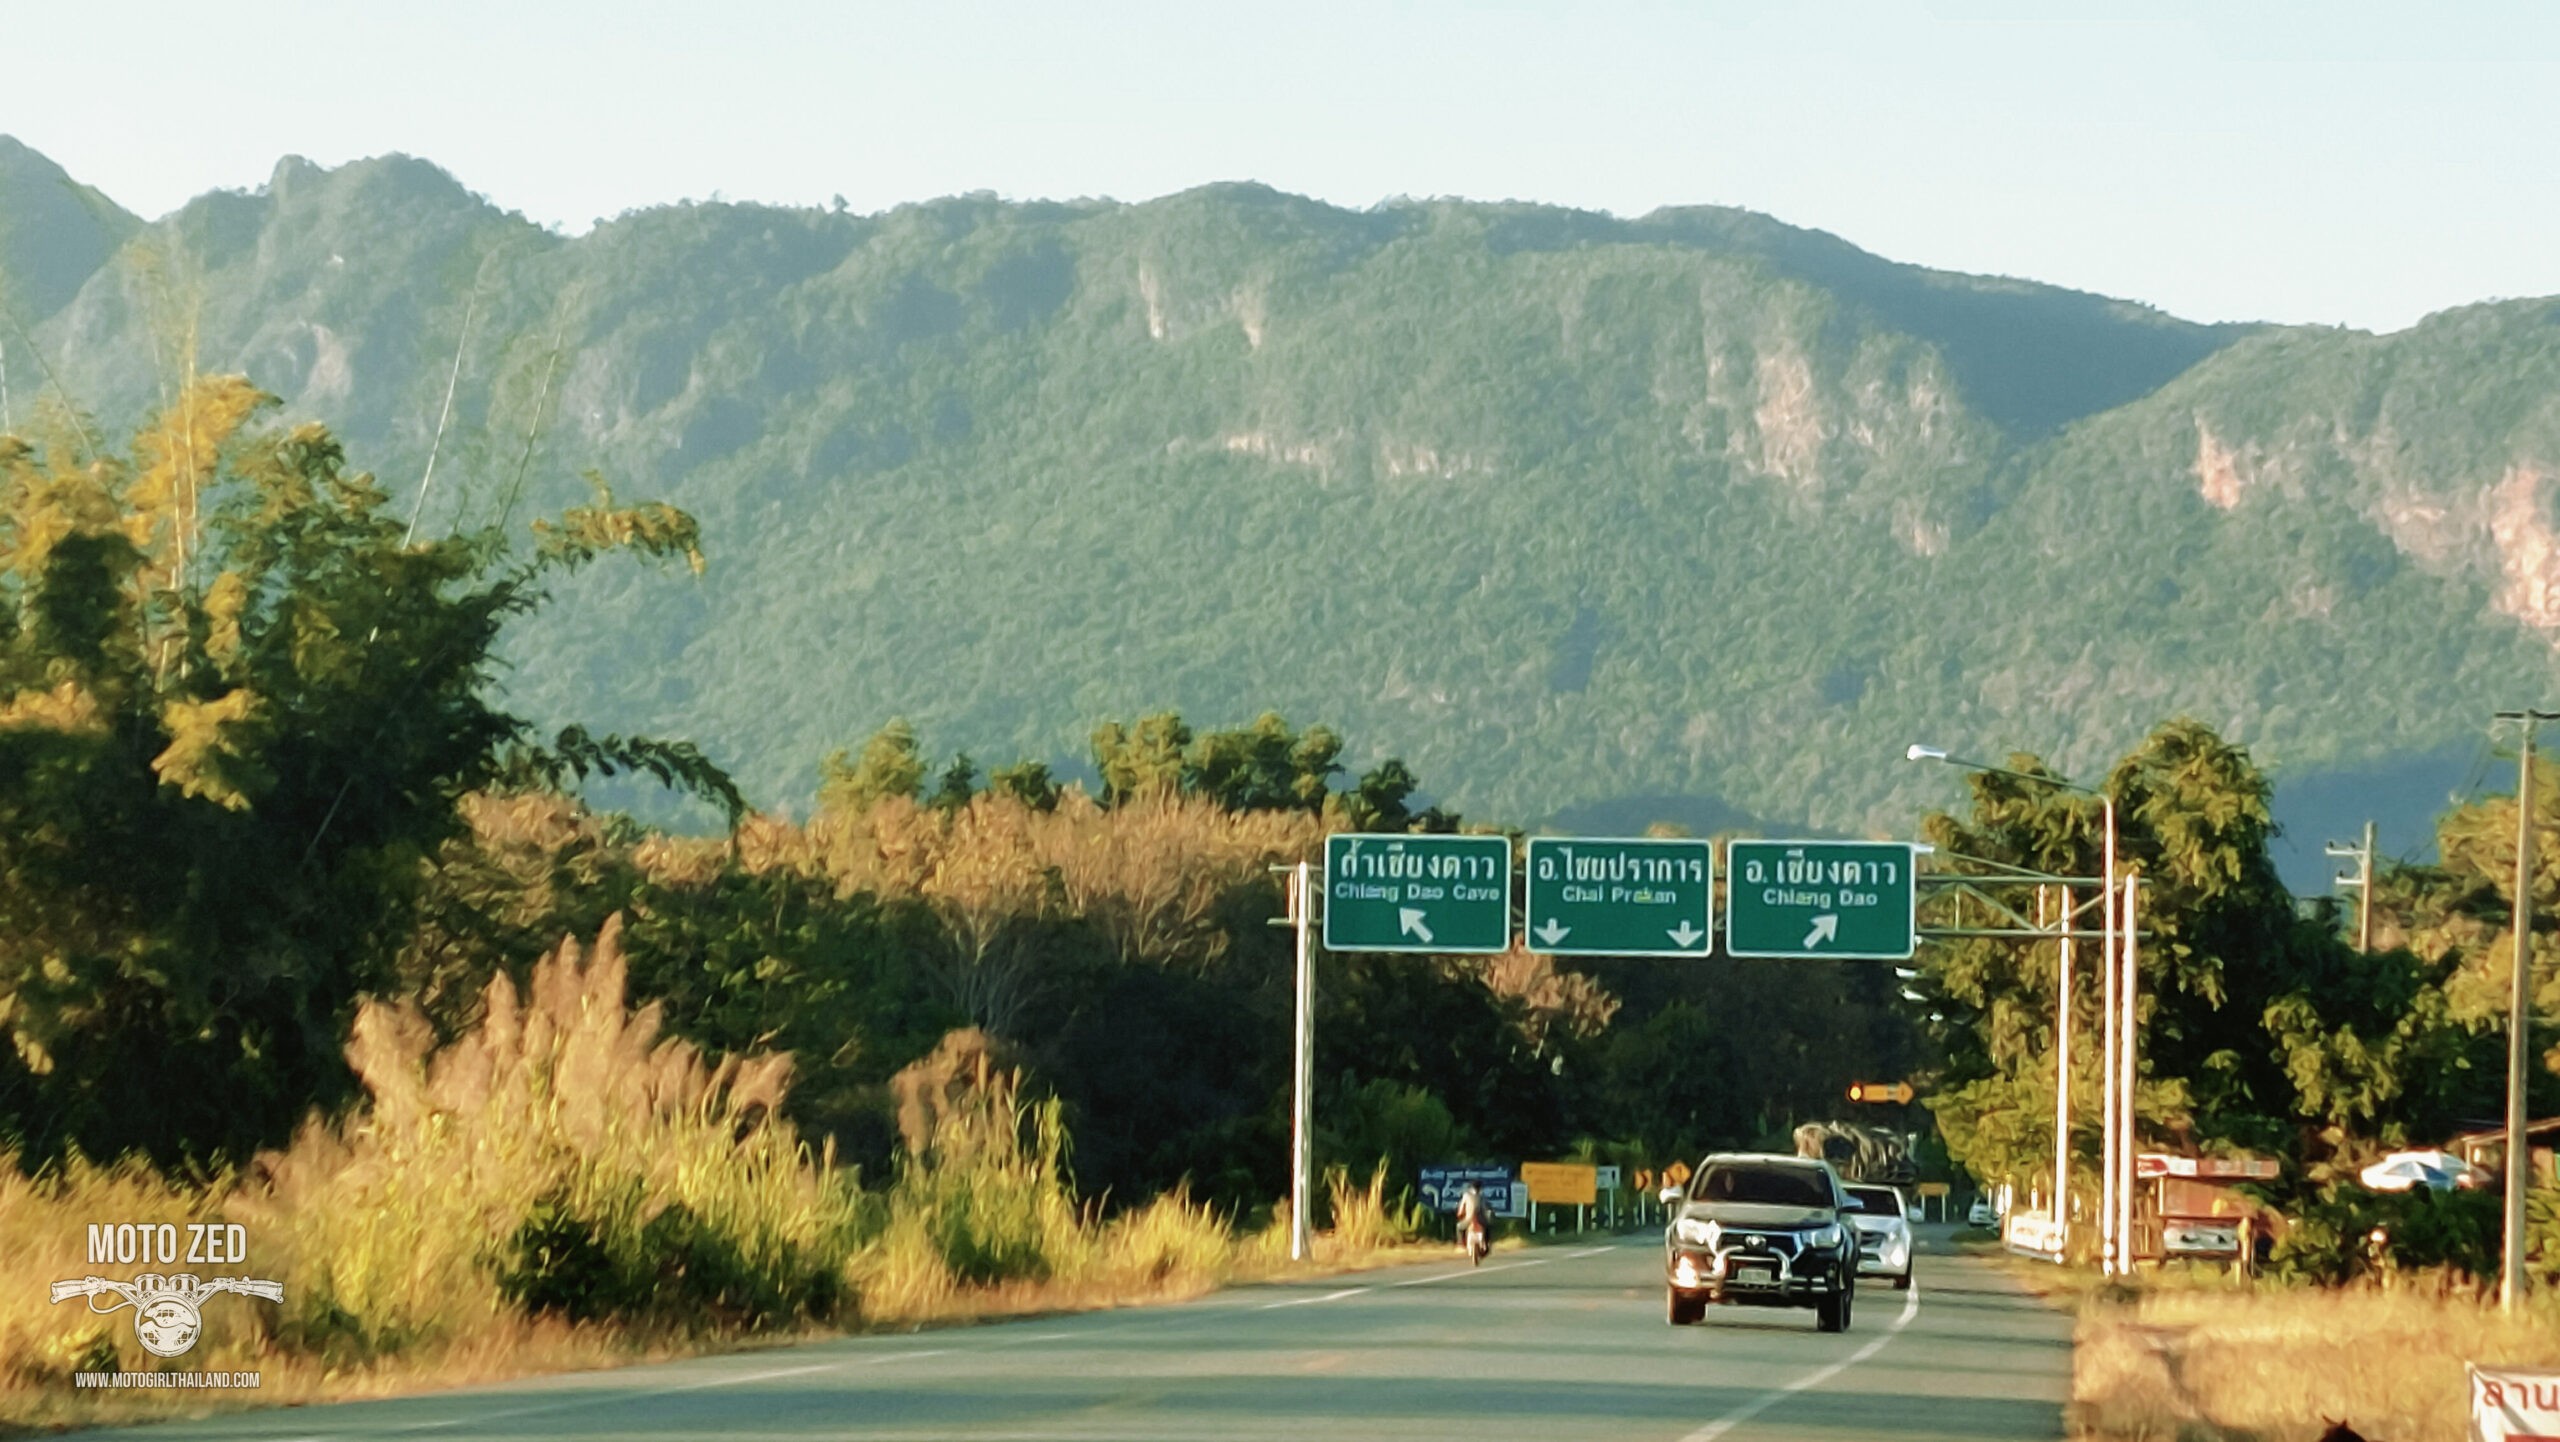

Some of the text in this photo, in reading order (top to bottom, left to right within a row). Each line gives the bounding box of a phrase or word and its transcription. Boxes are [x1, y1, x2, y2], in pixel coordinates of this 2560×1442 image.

[1341, 839, 1495, 880] ถ้ำเชียงดาว
[1335, 882, 1500, 903] Chiang Dao Cave
[1562, 885, 1603, 903] Chai
[1763, 888, 1878, 909] Chiang Dao
